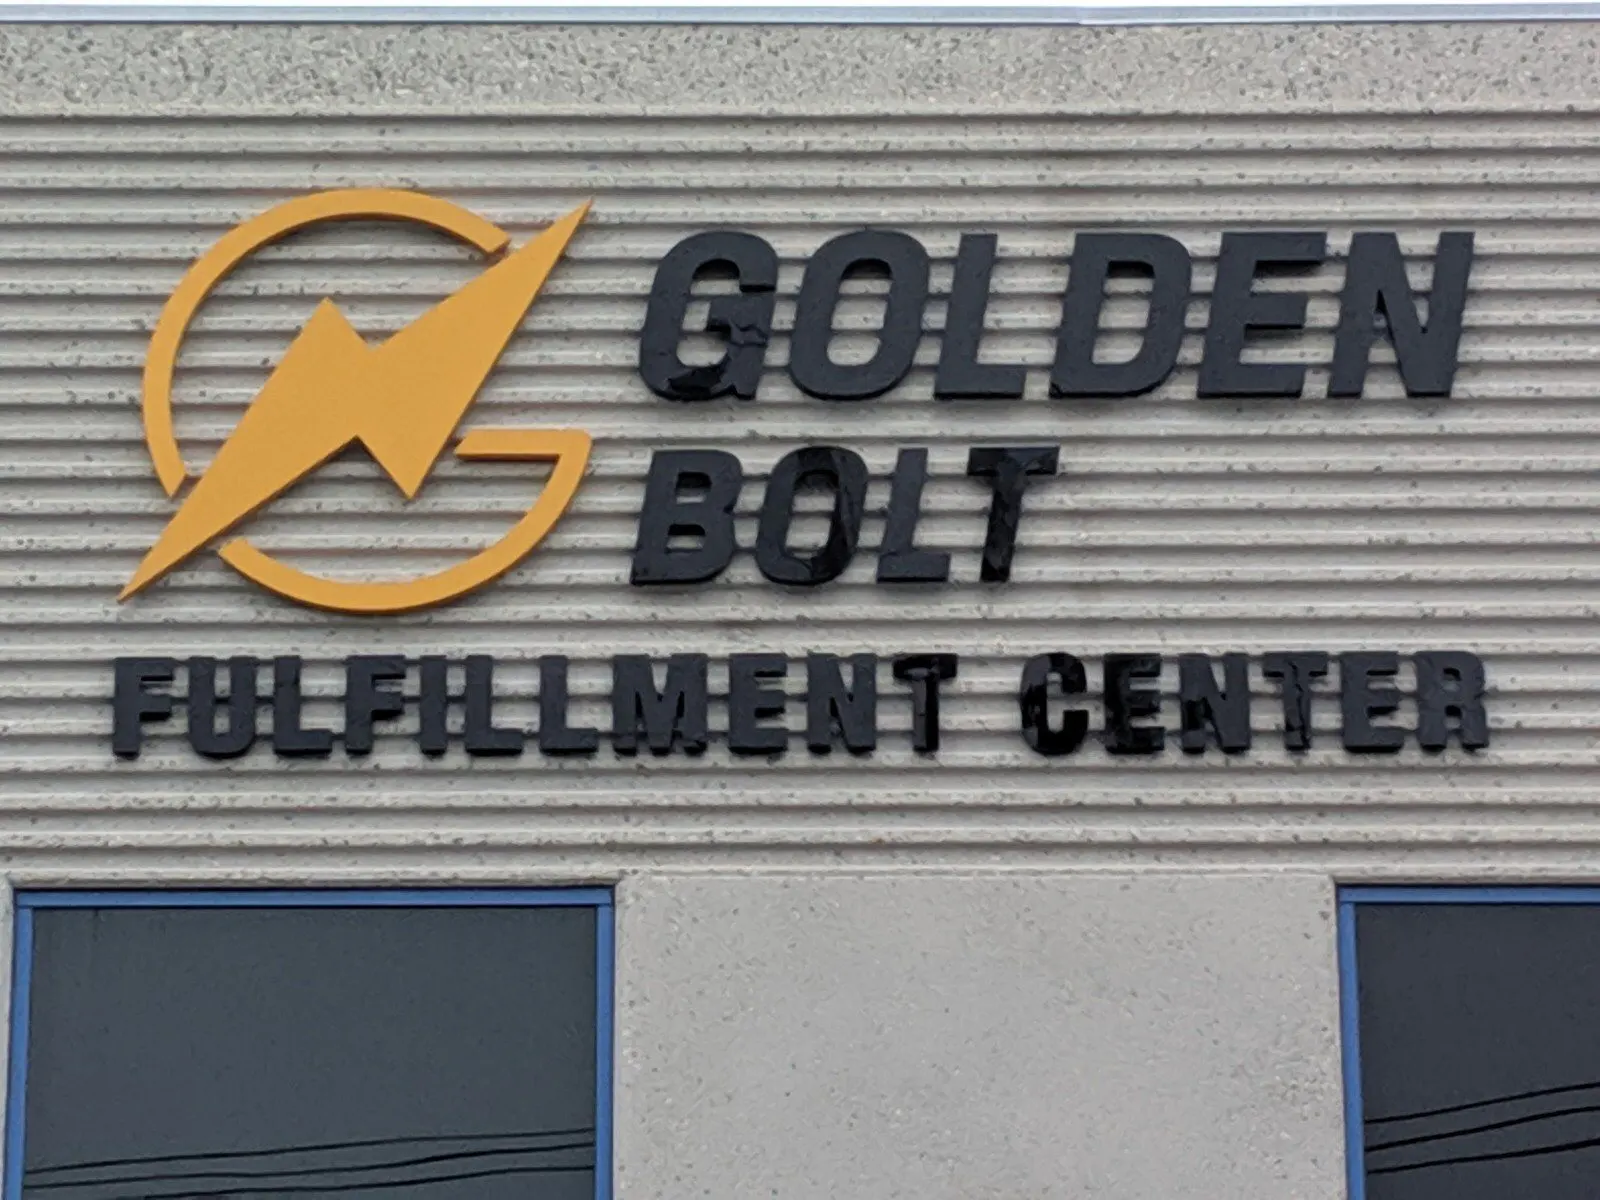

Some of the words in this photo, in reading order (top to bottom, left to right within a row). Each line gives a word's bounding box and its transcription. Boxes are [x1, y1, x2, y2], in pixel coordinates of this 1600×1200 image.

[639, 228, 1475, 402] GOLDEN
[630, 443, 1061, 587] BOLT
[112, 651, 958, 759] FULFILLMENT
[1021, 650, 1490, 756] CENTER
